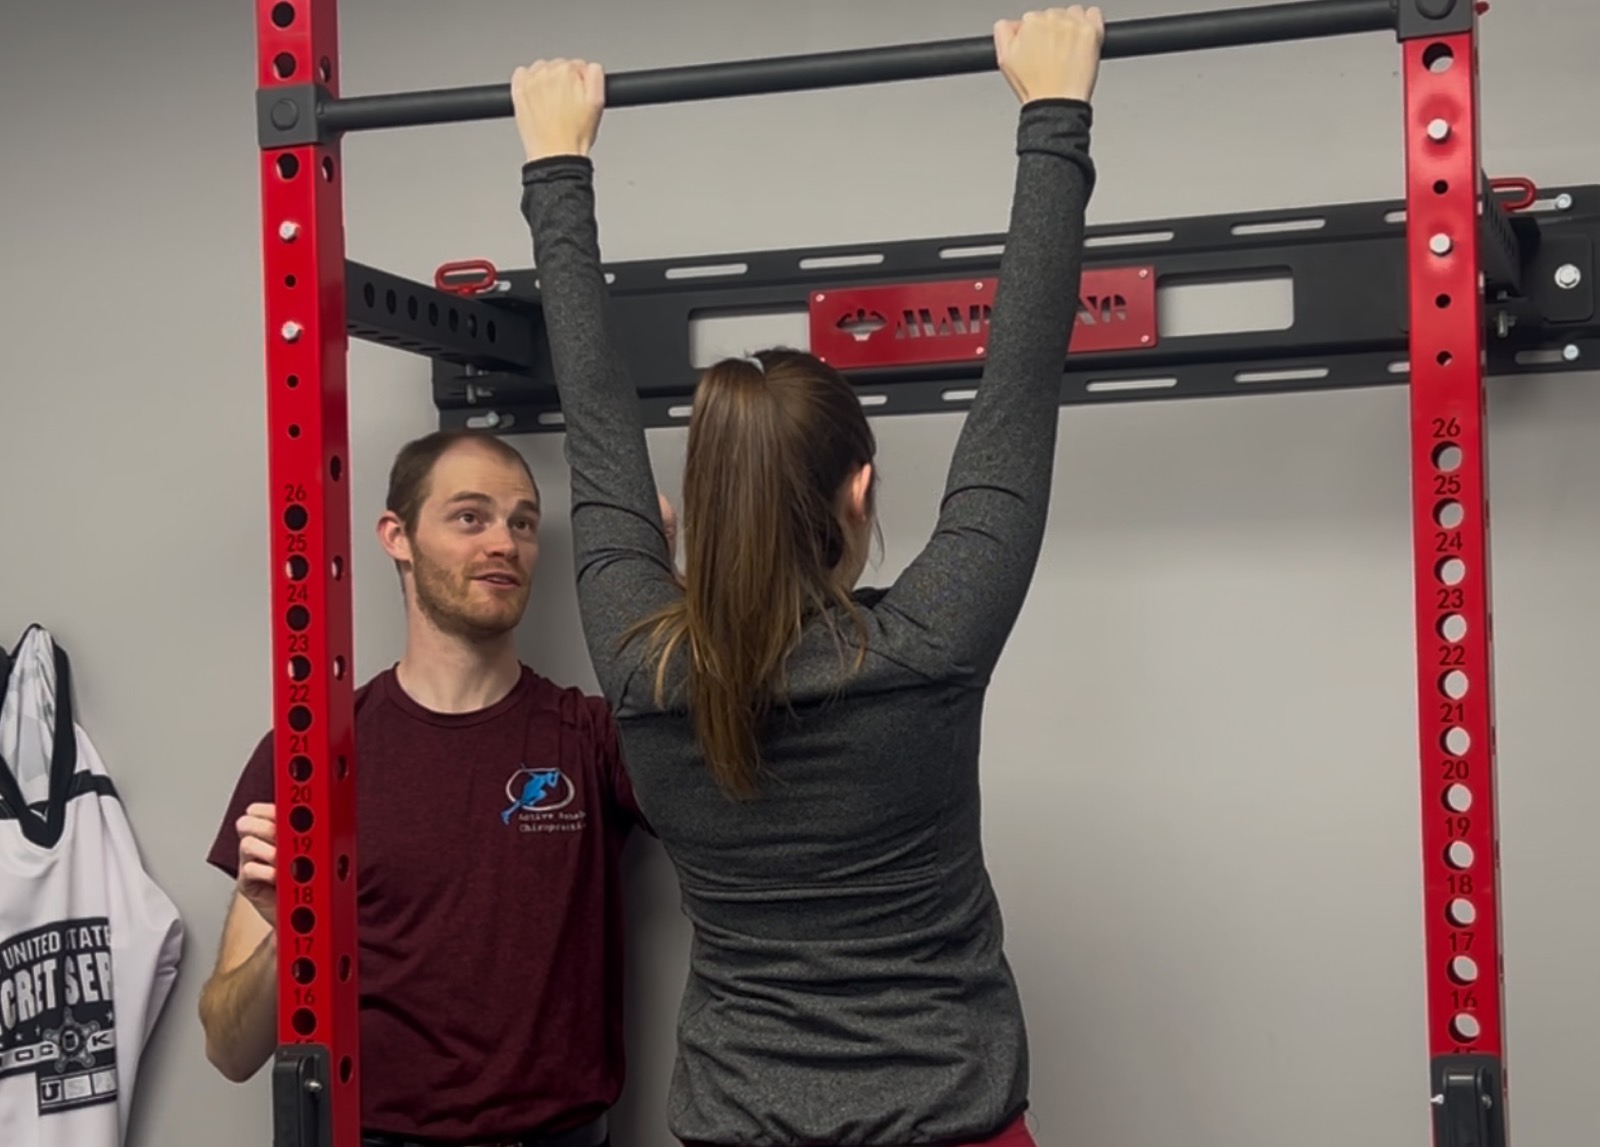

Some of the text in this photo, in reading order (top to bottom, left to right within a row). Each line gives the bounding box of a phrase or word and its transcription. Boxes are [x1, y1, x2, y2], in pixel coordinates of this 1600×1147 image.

[1432, 417, 1461, 438] 26
[285, 484, 307, 502] 26
[1434, 474, 1461, 495] 25
[286, 533, 308, 552] 25
[1435, 531, 1463, 551] 24
[287, 583, 309, 602] 24
[1437, 588, 1465, 609] 23
[287, 633, 310, 652] 23
[1438, 645, 1466, 666] 22
[289, 684, 311, 702] 22
[1440, 702, 1465, 723] 21
[290, 734, 309, 753] 21
[1442, 759, 1470, 780] 20
[291, 784, 313, 803] 20
[1444, 816, 1471, 838] 19
[292, 835, 313, 853] 19
[1446, 874, 1473, 895] 18
[293, 886, 314, 904] 18
[3, 931, 60, 969] UNITED
[294, 936, 315, 955] 17
[1448, 931, 1475, 952] 17
[294, 987, 316, 1006] 16
[1450, 989, 1478, 1010] 16
